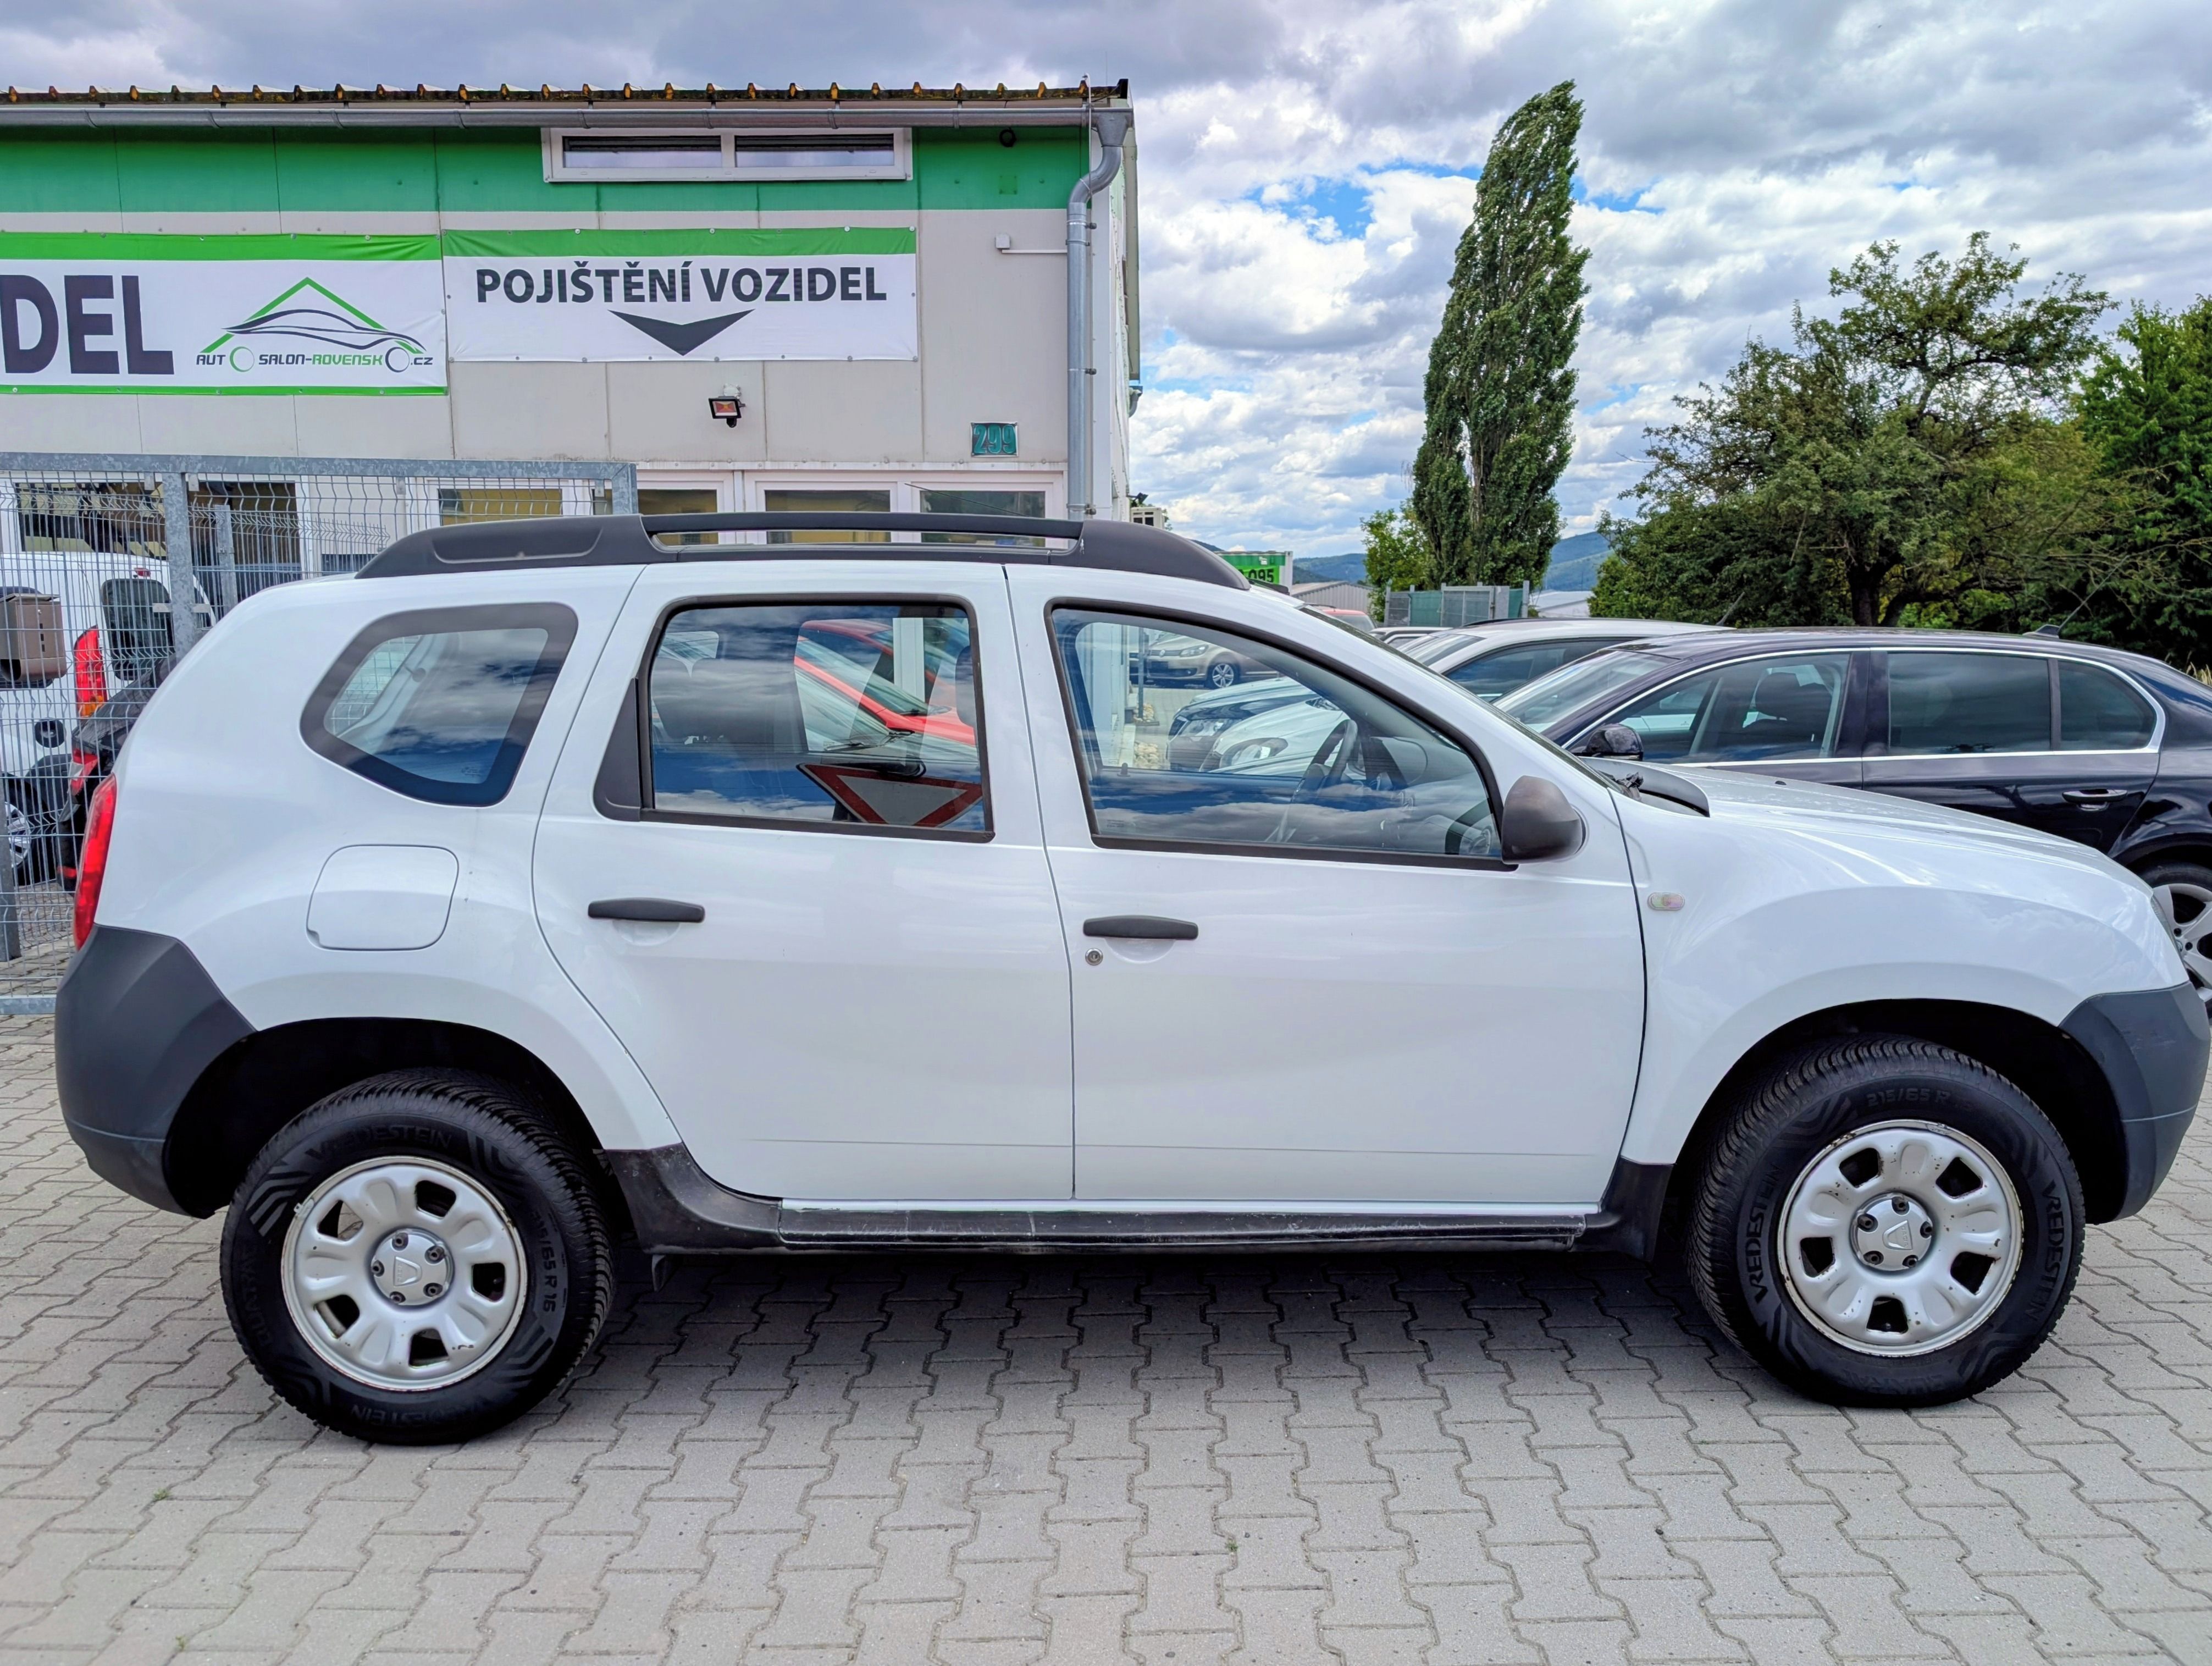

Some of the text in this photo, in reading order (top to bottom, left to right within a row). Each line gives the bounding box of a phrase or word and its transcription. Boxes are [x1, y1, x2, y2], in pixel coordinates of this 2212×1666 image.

[476, 261, 887, 303] POJIŠTĚNÍ VOZIDEL
[0, 274, 174, 374] DEL
[974, 424, 1016, 454] 299
[1866, 1088, 1931, 1107] 215/65
[1745, 1163, 1783, 1304] VREDESTEIN
[2025, 1180, 2065, 1321] VREDESTEIN
[543, 1293, 557, 1312] 16
